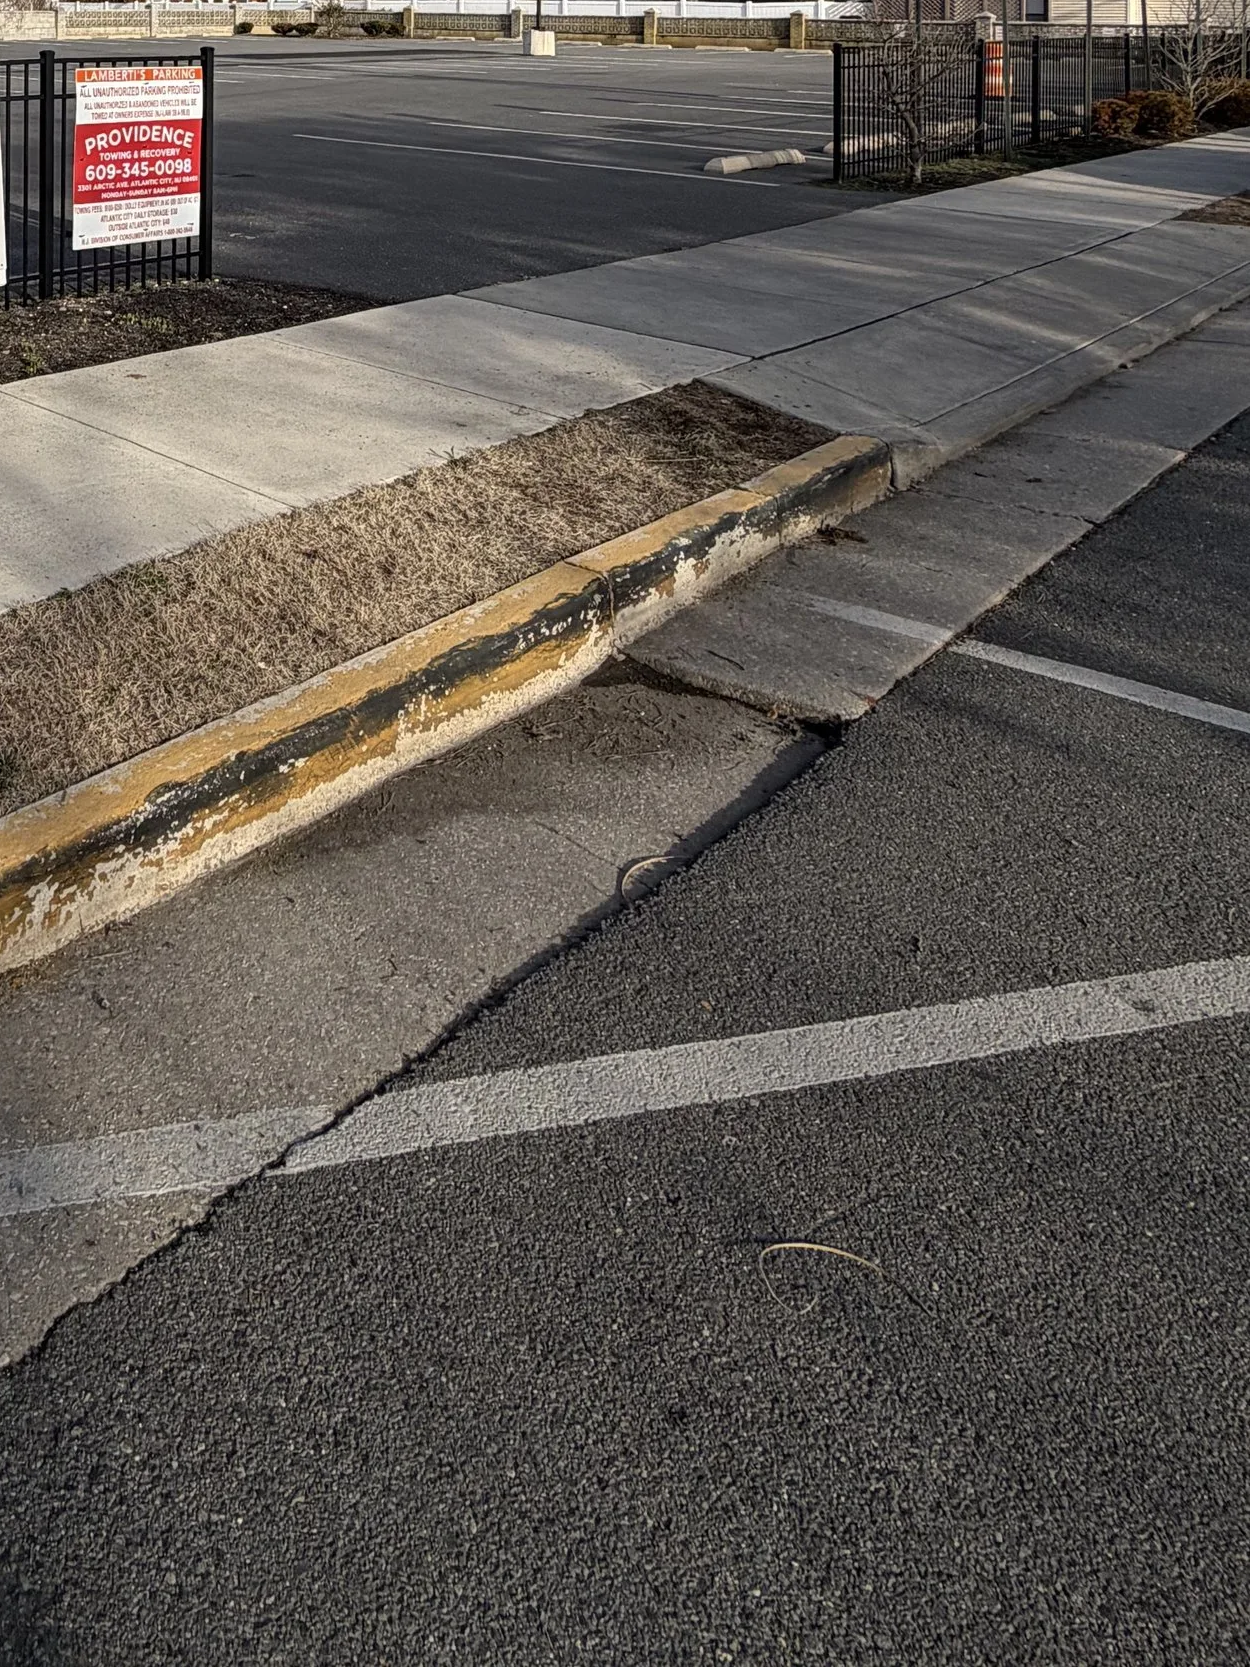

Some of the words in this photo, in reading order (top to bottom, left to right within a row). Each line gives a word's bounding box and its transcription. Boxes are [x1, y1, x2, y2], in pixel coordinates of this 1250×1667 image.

[84, 69, 146, 82] LAMBERTI'S
[152, 68, 196, 80] PARKING
[80, 87, 91, 98] ALL
[93, 86, 140, 98] UNAUTHORIZED
[141, 85, 167, 96] PARKING
[167, 84, 201, 95] PROHIBITED
[84, 125, 195, 155] PROVIDENCE
[99, 151, 131, 161] TOWING
[133, 150, 139, 159] &
[140, 148, 181, 159] RECOVERY
[85, 158, 193, 181] 609-345-0098
[93, 182, 115, 191] ARCTIC
[130, 178, 159, 188] ATLANTIC
[159, 176, 174, 185] CITY,
